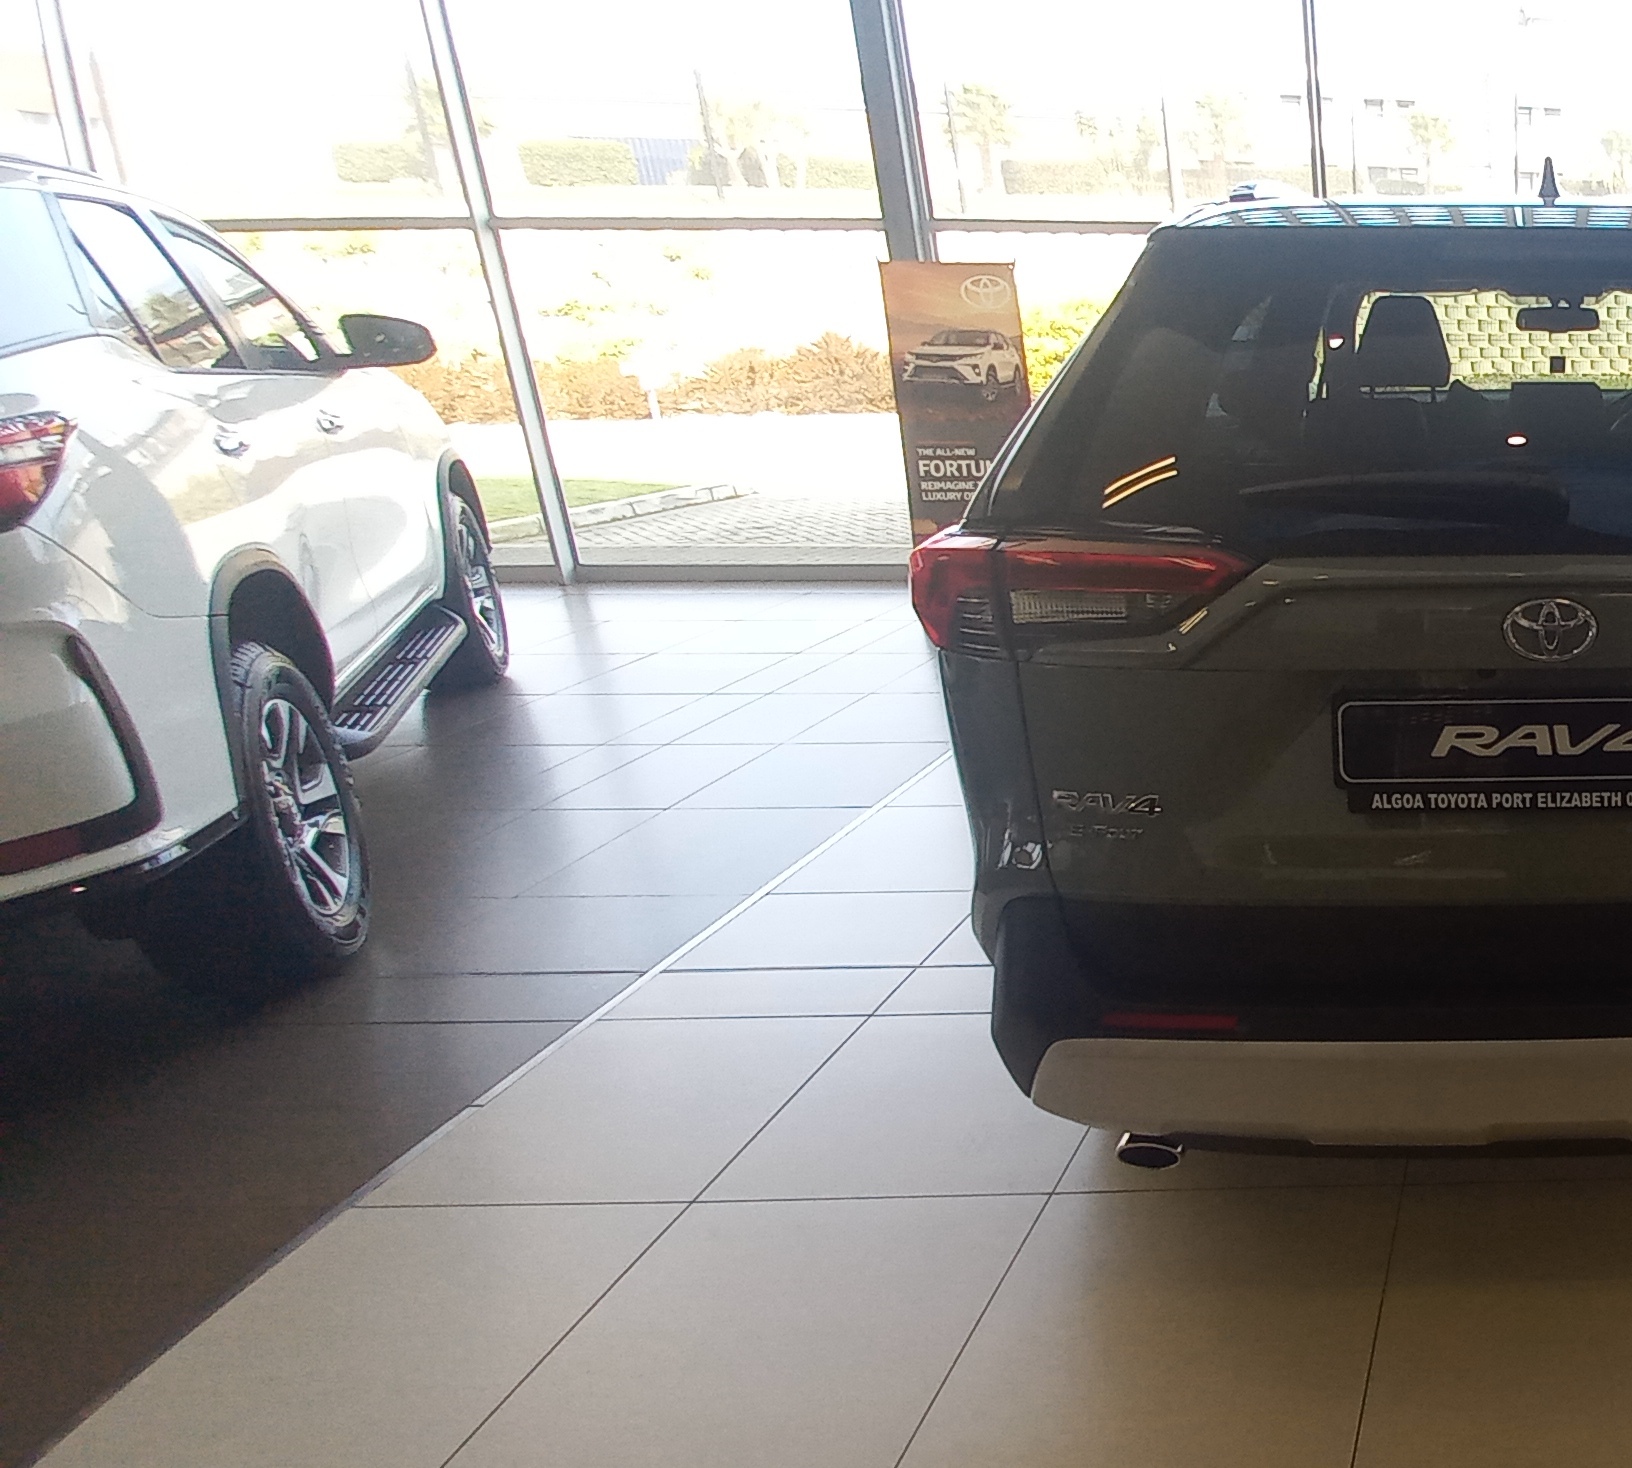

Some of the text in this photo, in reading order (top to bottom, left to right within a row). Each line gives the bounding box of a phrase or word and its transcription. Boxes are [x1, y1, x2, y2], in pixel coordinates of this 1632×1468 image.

[917, 447, 975, 456] THE ALL-NEW
[921, 481, 976, 490] REIMAGINE
[922, 492, 962, 501] LUXURY
[1052, 789, 1163, 817] RAV4
[1371, 793, 1425, 809] ALGOA
[1428, 793, 1490, 809] TOYOTA
[1491, 793, 1533, 809] PORT
[1537, 791, 1622, 808] ELIZABETH
